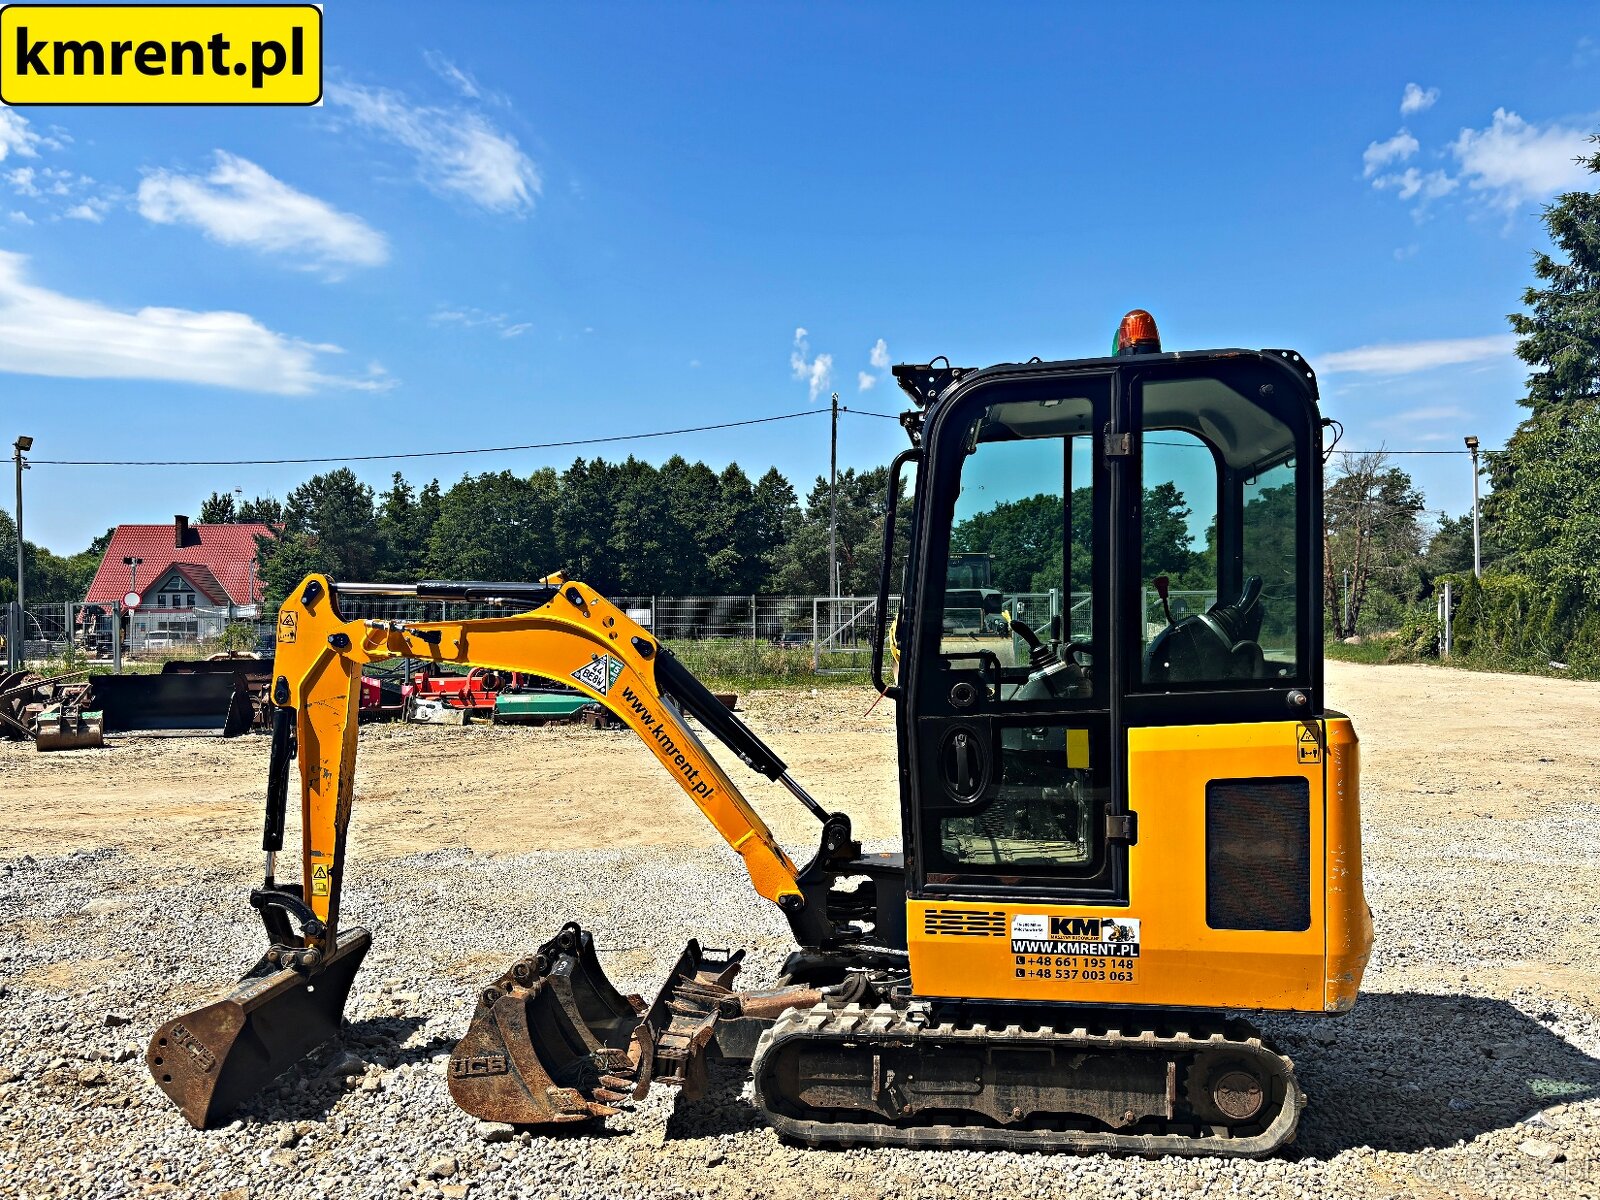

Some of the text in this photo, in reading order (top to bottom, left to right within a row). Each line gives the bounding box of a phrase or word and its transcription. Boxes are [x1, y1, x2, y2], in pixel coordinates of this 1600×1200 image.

[621, 686, 715, 799] www.kmrent.pl
[1050, 917, 1100, 937] KM
[1012, 940, 1138, 956] WWW.KMRENT.PL
[1028, 956, 1134, 969] +48 661 195 148
[1028, 969, 1134, 981] +48 537 003 063
[450, 1055, 508, 1078] JCB
